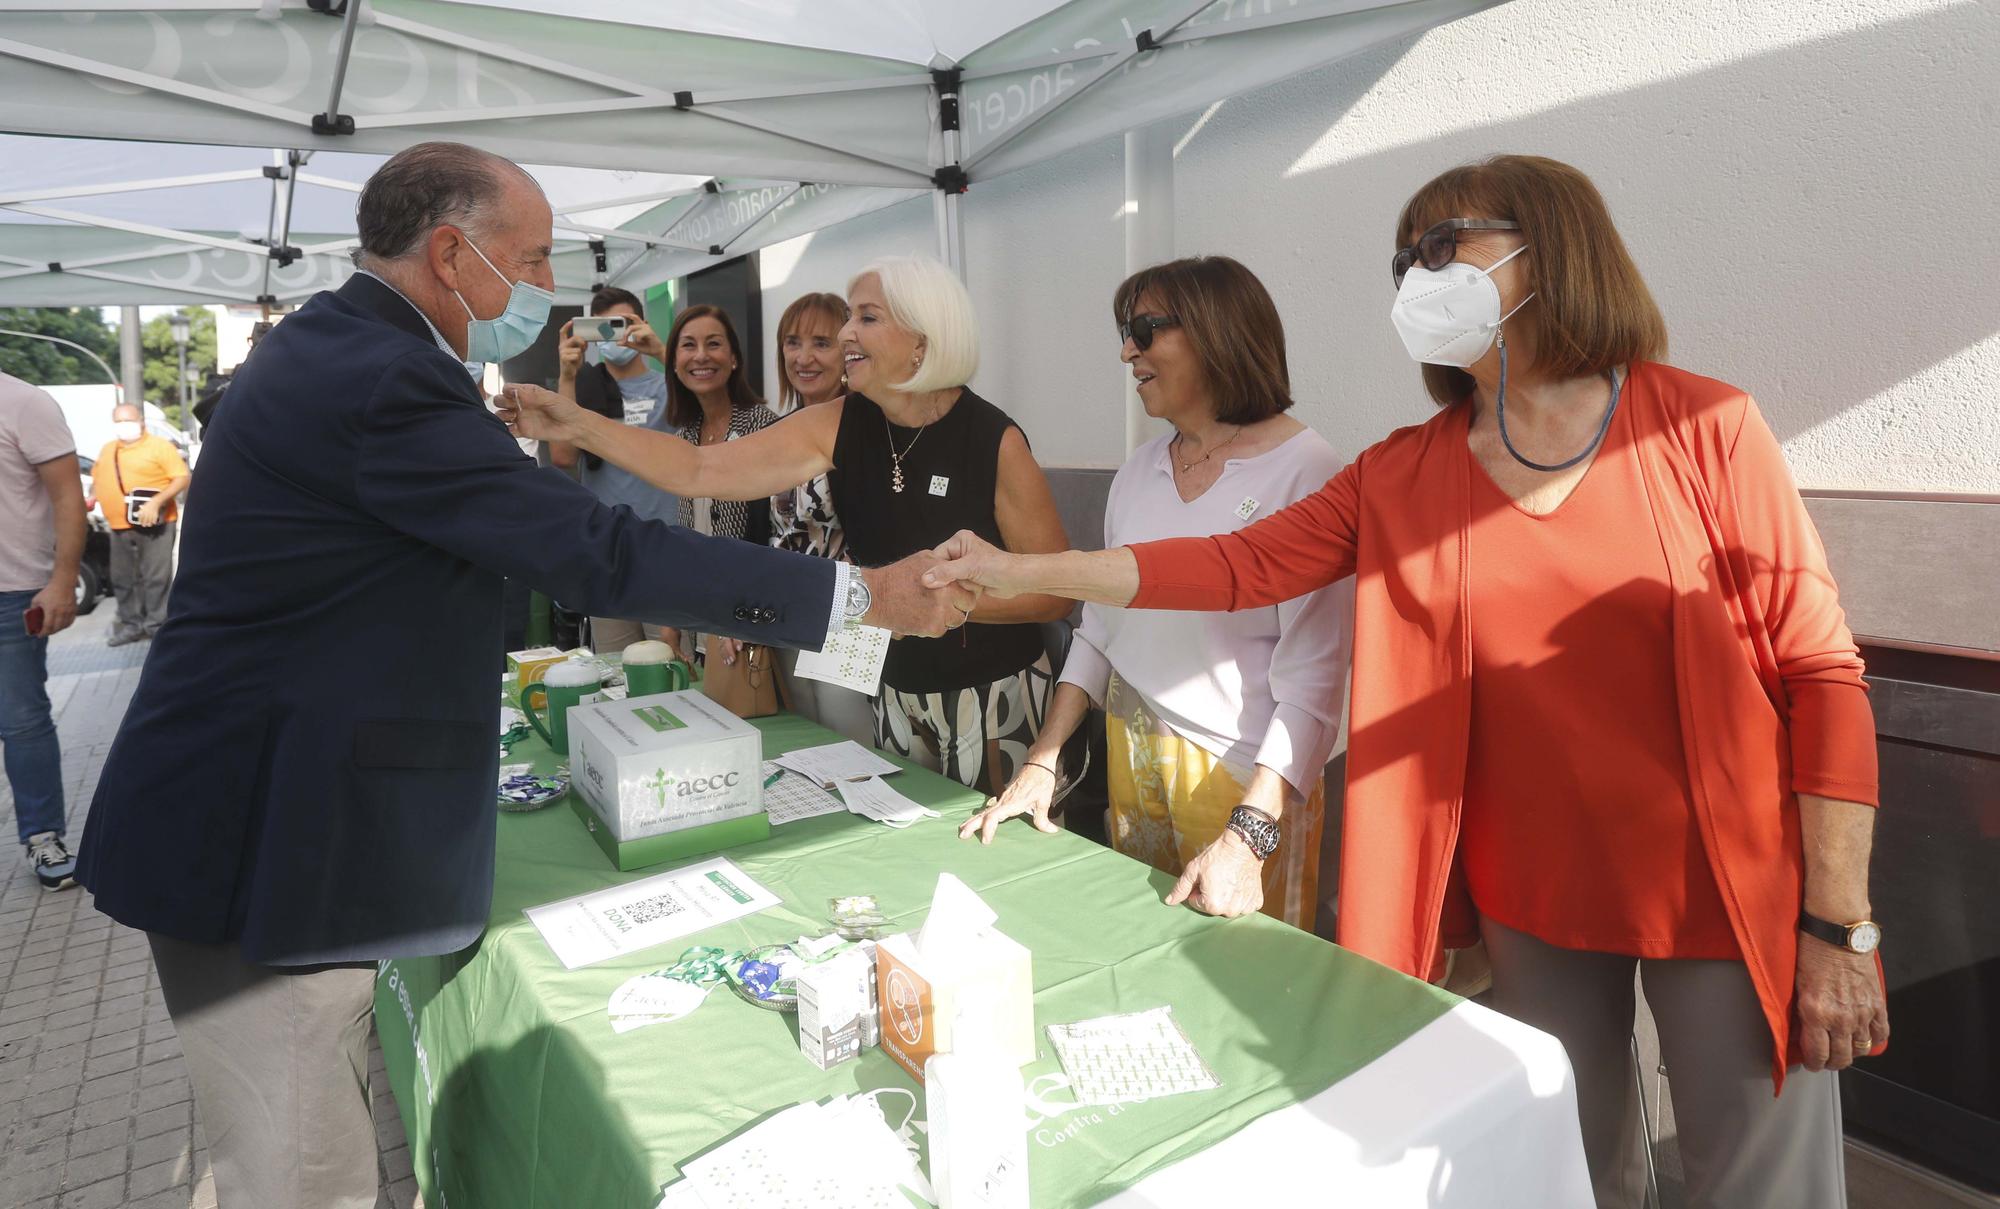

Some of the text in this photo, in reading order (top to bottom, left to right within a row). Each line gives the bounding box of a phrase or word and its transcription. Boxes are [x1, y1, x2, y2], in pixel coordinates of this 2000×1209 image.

[677, 771, 740, 798] aecc
[603, 908, 631, 935] DONA
[1035, 1102, 1126, 1149] Contra el
